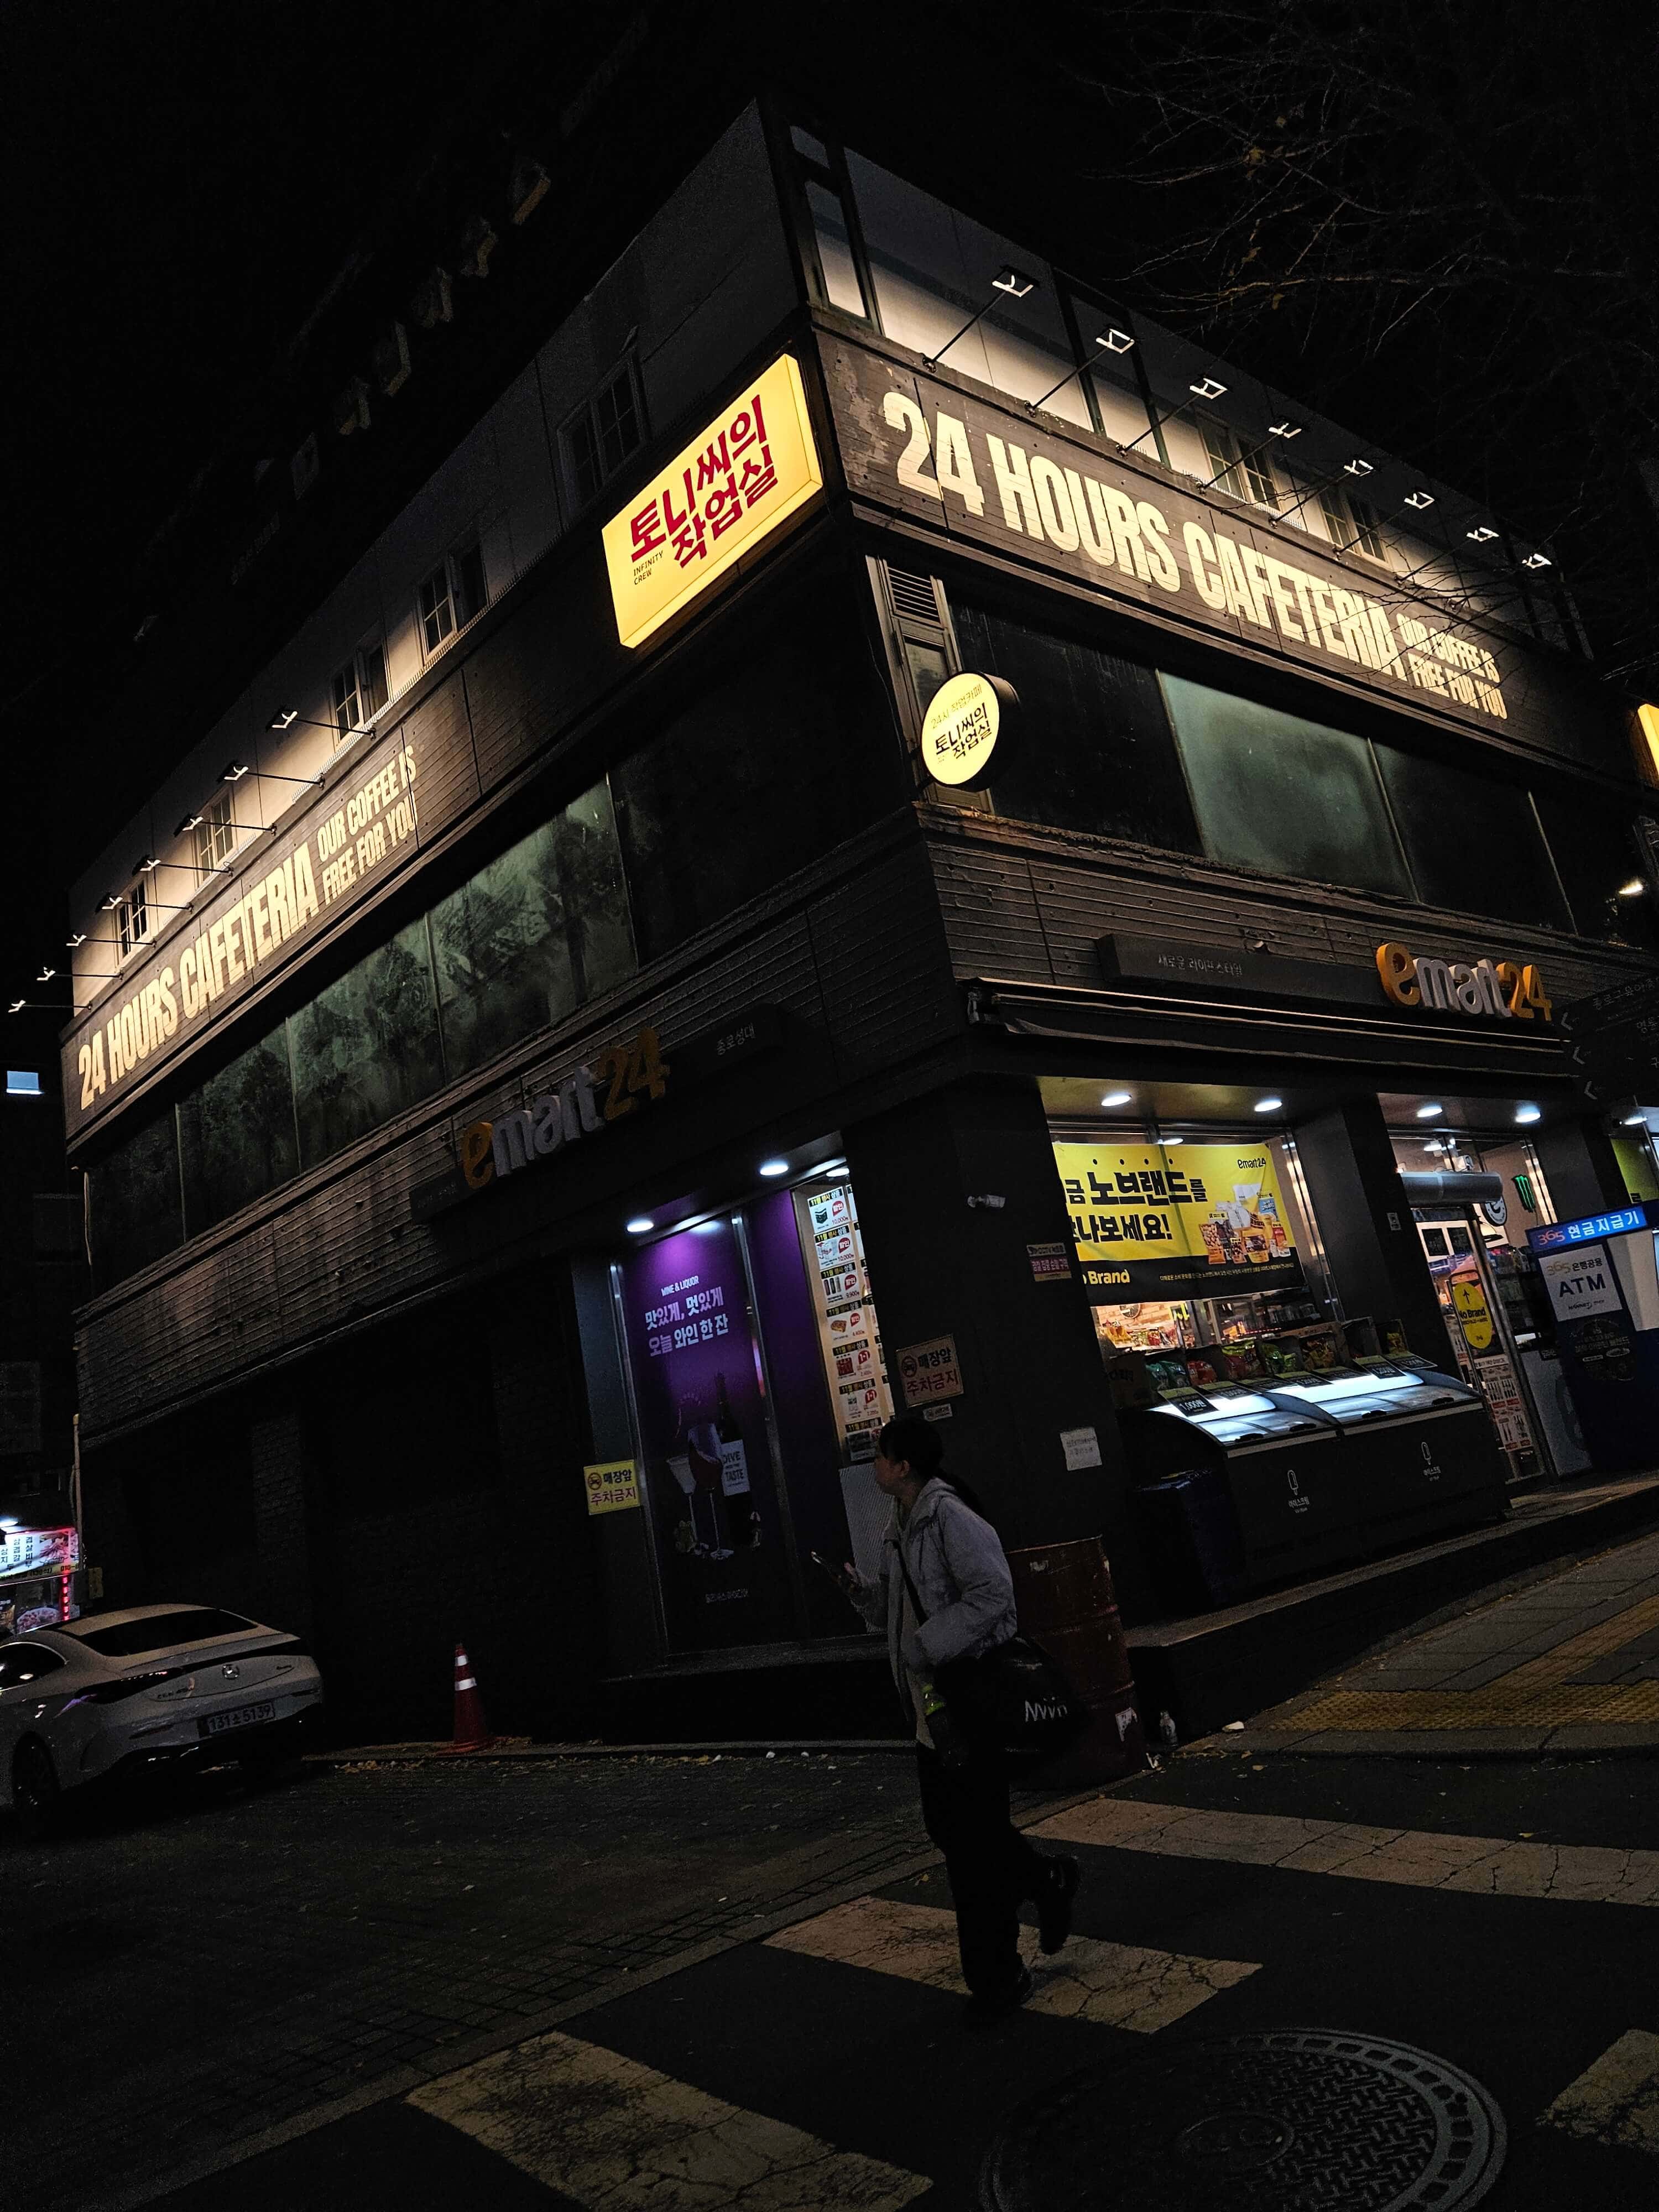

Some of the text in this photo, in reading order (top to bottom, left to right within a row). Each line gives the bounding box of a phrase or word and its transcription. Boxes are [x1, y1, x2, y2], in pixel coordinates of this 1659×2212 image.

[630, 395, 767, 562] 토니씨의
[672, 444, 778, 568] 작업실
[884, 392, 1408, 682] 24 HOURS CAFETERIA
[634, 550, 663, 576] INFINITY
[634, 568, 651, 585] CREW
[1396, 613, 1500, 684] OUR COFFEE IS
[1407, 652, 1507, 719] FREE FOR YOU
[936, 702, 988, 755] 토니씨의
[953, 720, 992, 759] 작업실
[317, 745, 416, 862] OUR COFFEE IS
[322, 791, 418, 905] FREE FOR YOU
[78, 841, 320, 1110] 24 HOURS CAFETERIA
[1159, 954, 1185, 970] 새로운
[1376, 942, 1553, 1022] emart24
[460, 1026, 671, 1190] emart24
[1238, 1157, 1266, 1168] emart24
[1065, 1170, 1208, 1206] 금 노브랜드를
[1538, 1211, 1640, 1245] 365 현금지급기
[1087, 1269, 1130, 1285] Brand
[1546, 1258, 1603, 1275] 365 은행공용
[661, 1275, 699, 1297] WINE & LIQUOR
[1559, 1274, 1606, 1297] ATM
[645, 1286, 724, 1331] 맛있게, 멋있게
[649, 1313, 729, 1357] 오늘 와인 한 잔
[917, 1348, 952, 1368] 매장앞
[906, 1369, 958, 1396] 주차금지
[604, 1469, 632, 1484] 매장앞
[591, 1486, 636, 1505] 주차금지
